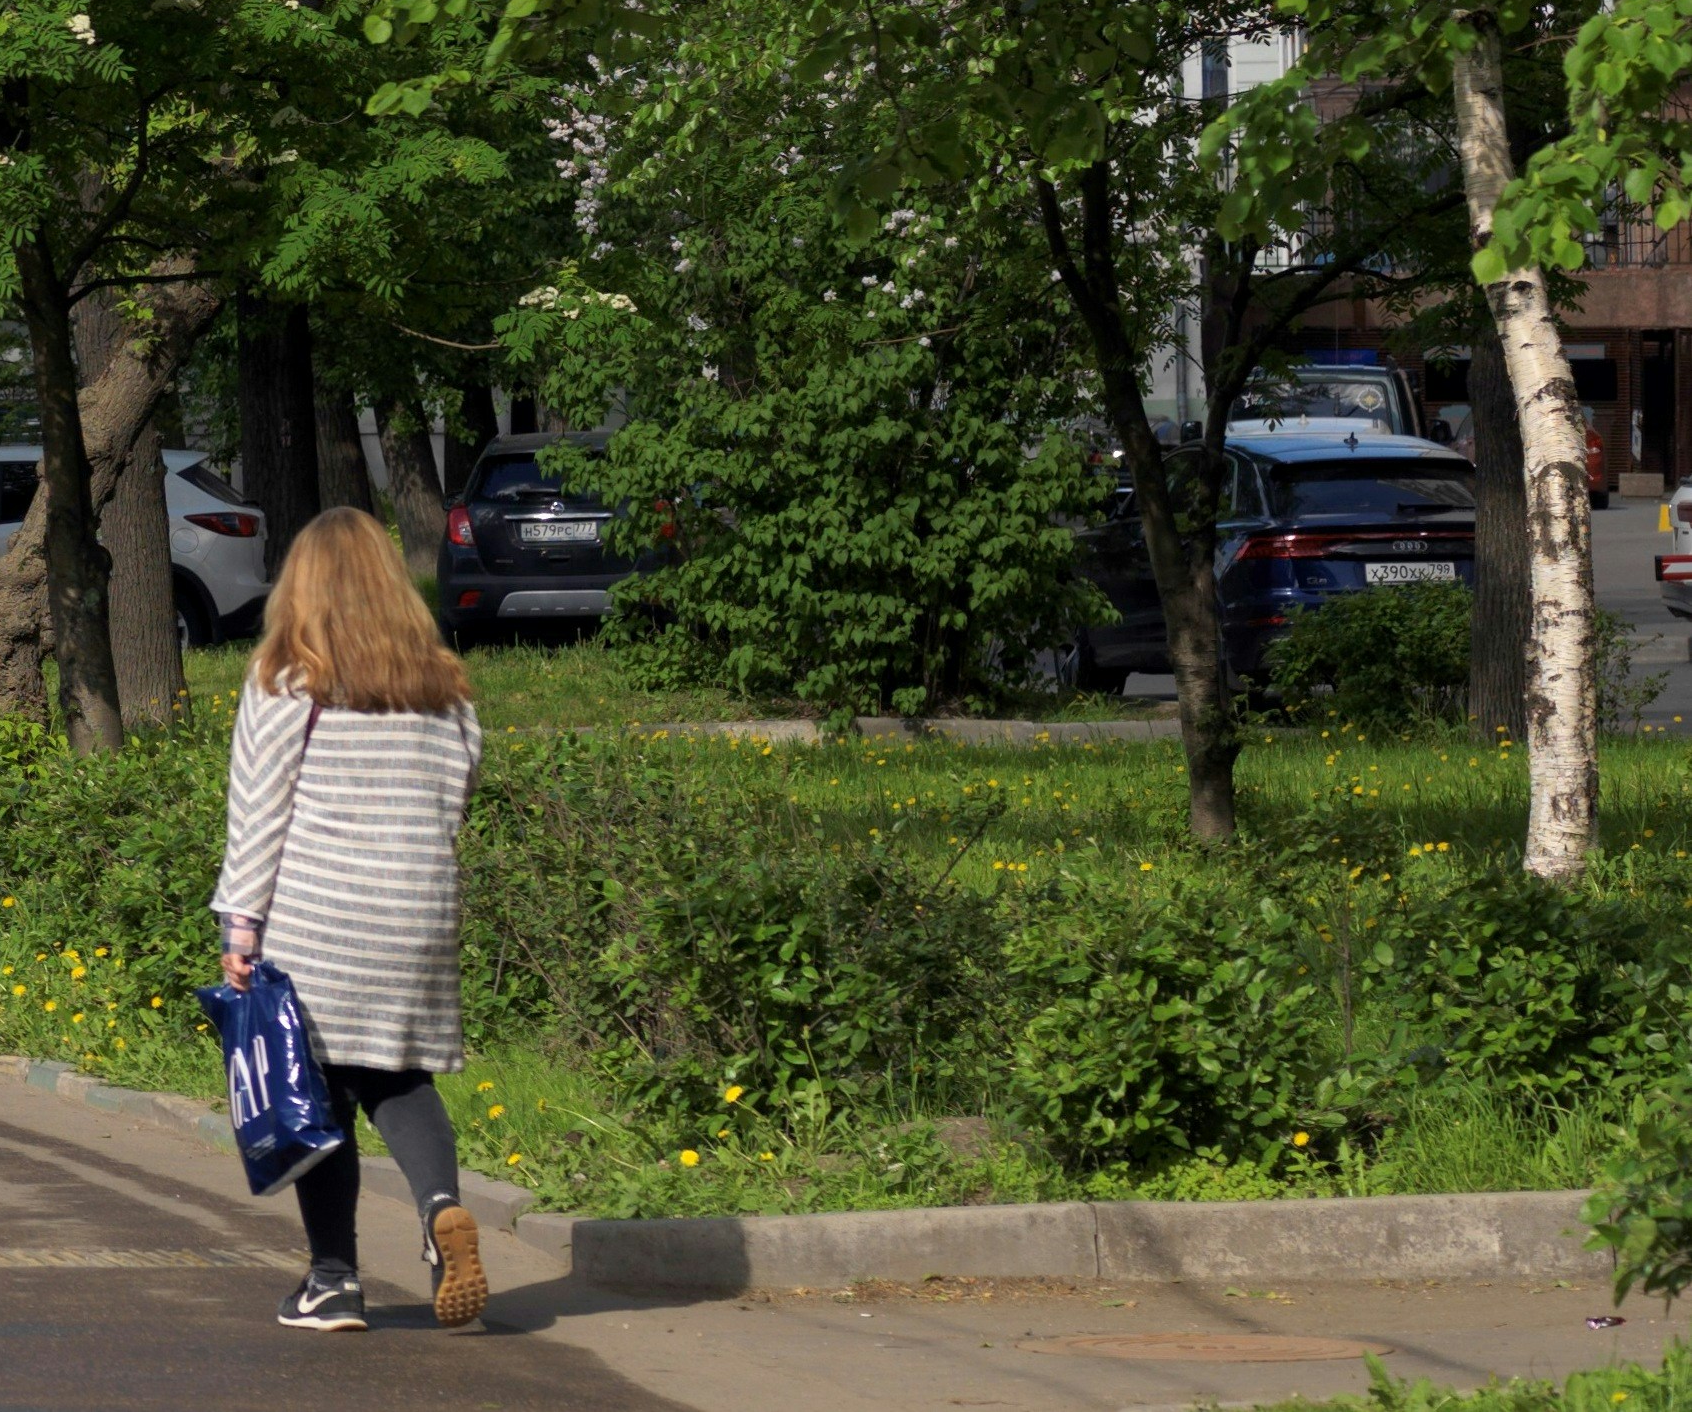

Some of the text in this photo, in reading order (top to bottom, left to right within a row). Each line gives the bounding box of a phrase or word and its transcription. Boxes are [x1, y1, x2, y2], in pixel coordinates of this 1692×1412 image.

[525, 522, 593, 537] Н579РС 777
[1371, 564, 1451, 580] Х390ХК 799
[229, 1035, 271, 1130] GAP
